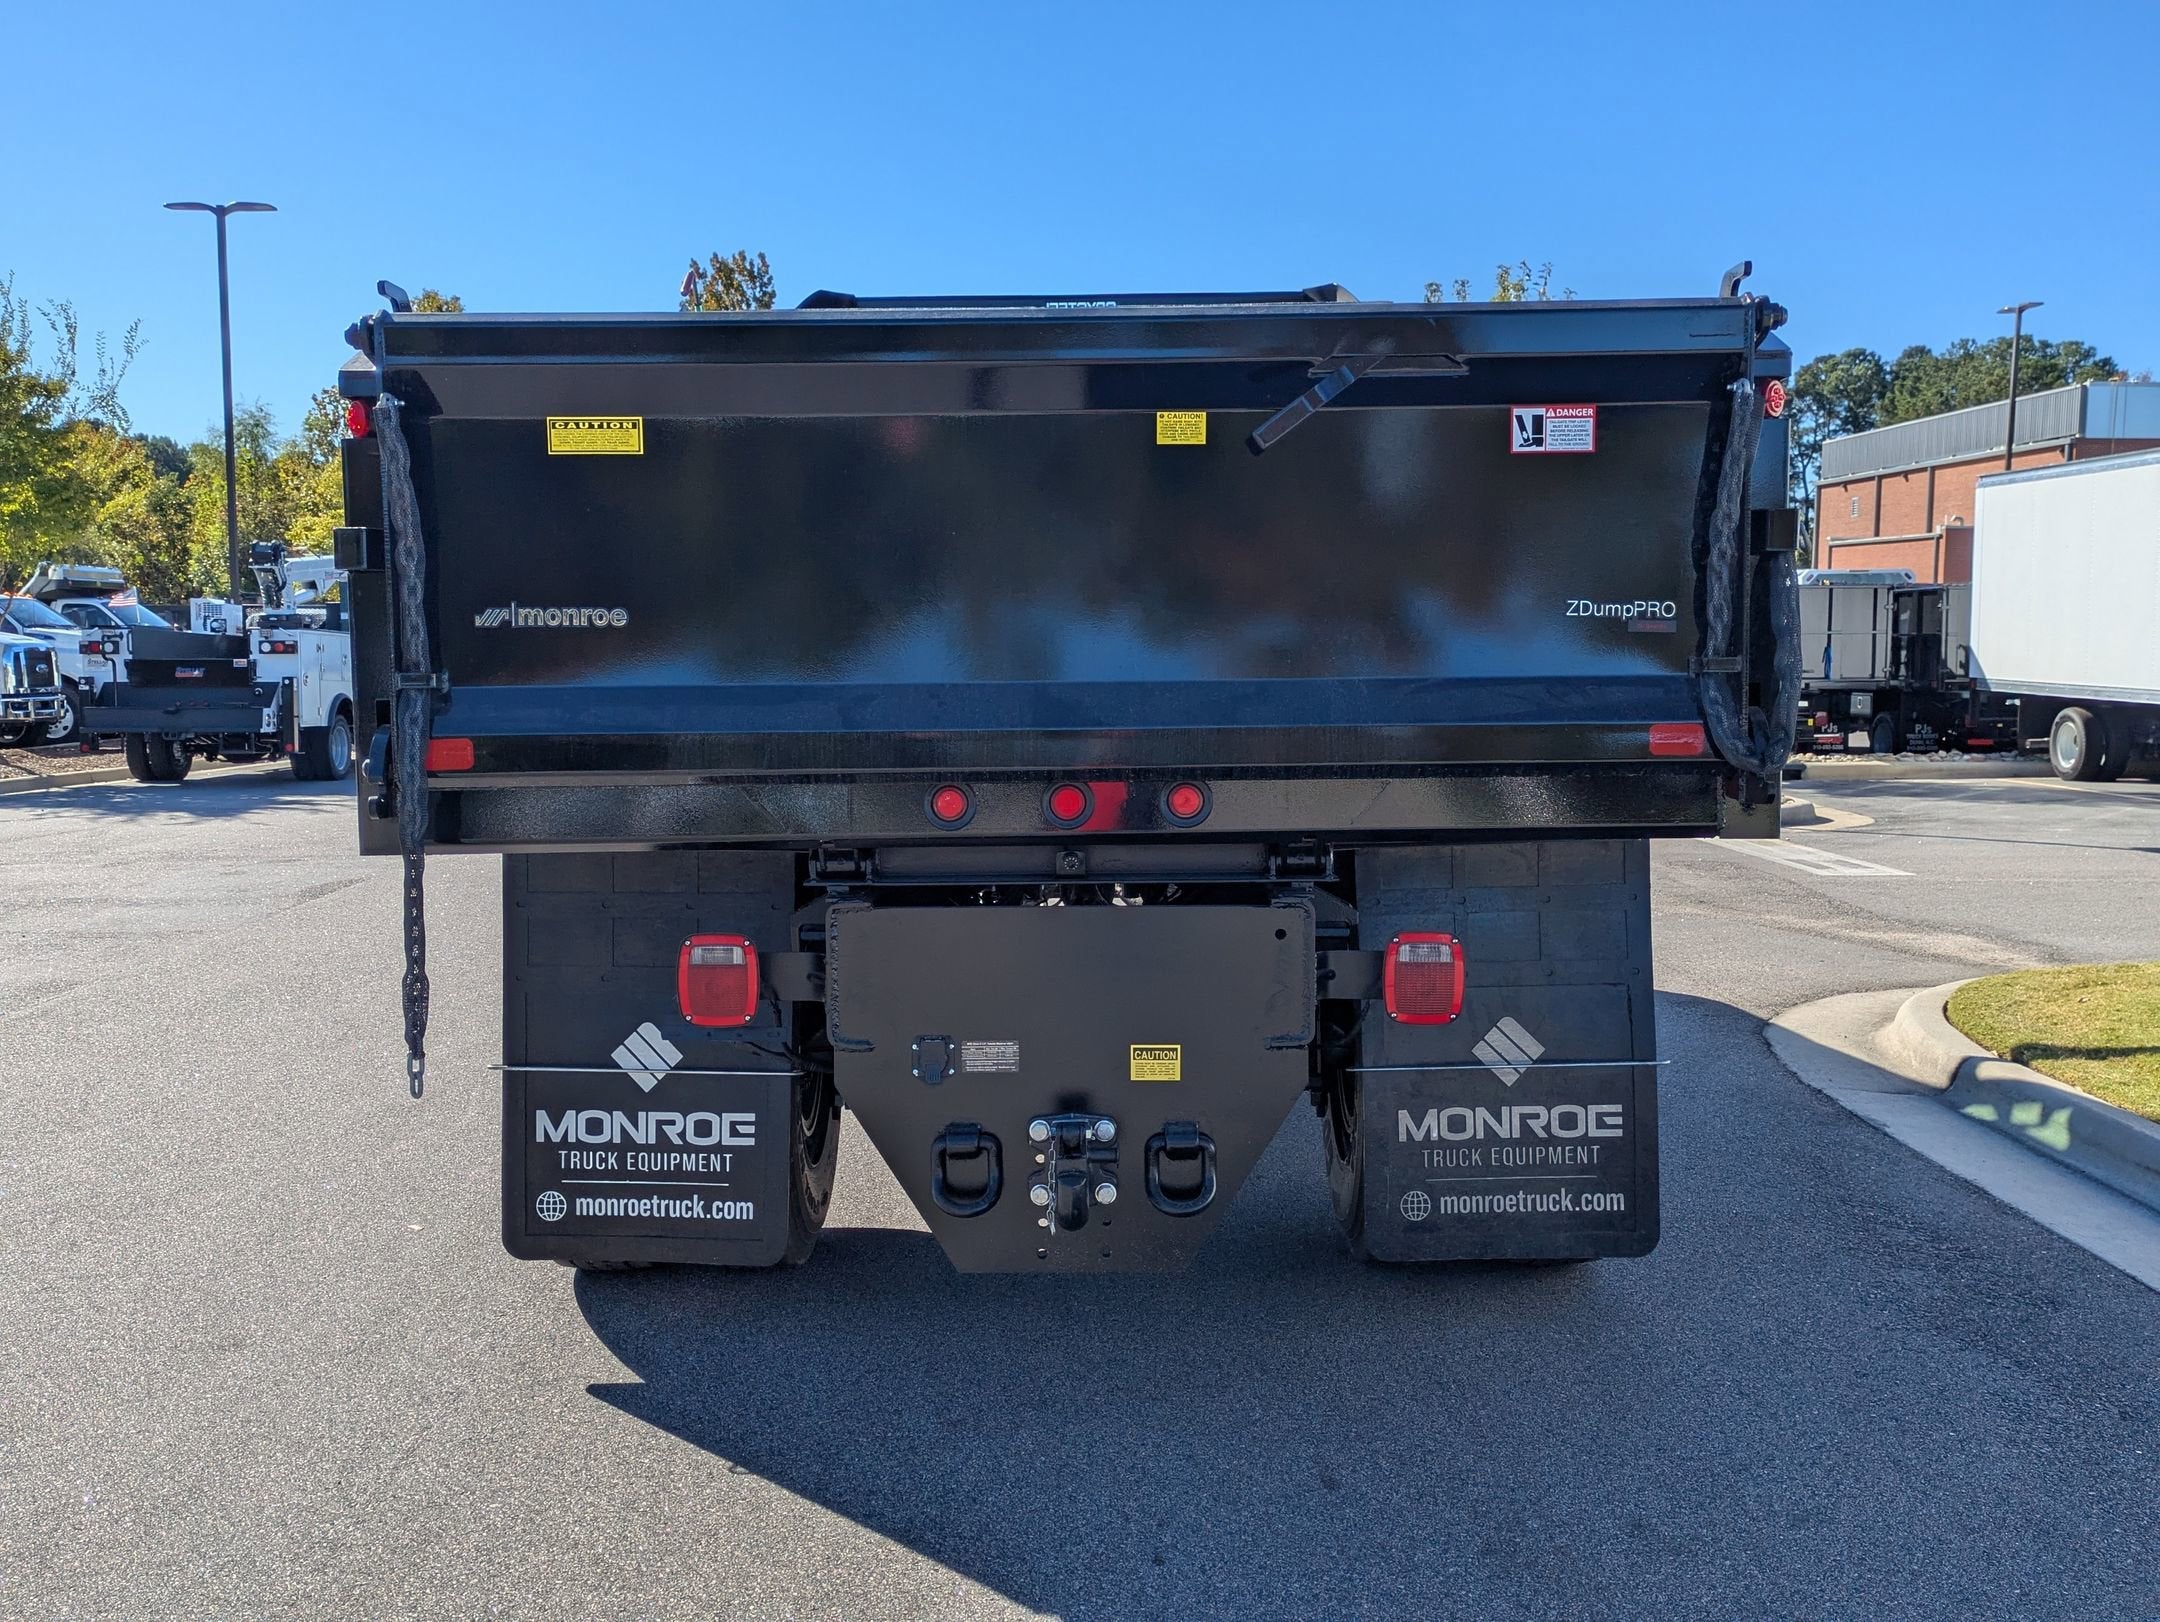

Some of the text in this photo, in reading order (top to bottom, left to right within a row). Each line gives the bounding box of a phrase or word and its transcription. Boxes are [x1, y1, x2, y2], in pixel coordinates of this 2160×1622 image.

[1556, 408, 1594, 417] DANGER
[518, 608, 628, 627] monroe
[1566, 600, 1676, 621] ZDumpPRO
[1134, 1050, 1177, 1060] CAUTION
[535, 1109, 756, 1146] MONROE
[1398, 1104, 1623, 1142] MONROE
[558, 1150, 733, 1173] TRUCK EQUIPMENT
[1422, 1145, 1601, 1168] TRUCK EQUIPMENT
[575, 1194, 754, 1220] monroetruck.com
[1440, 1187, 1625, 1214] monroetruck.com
